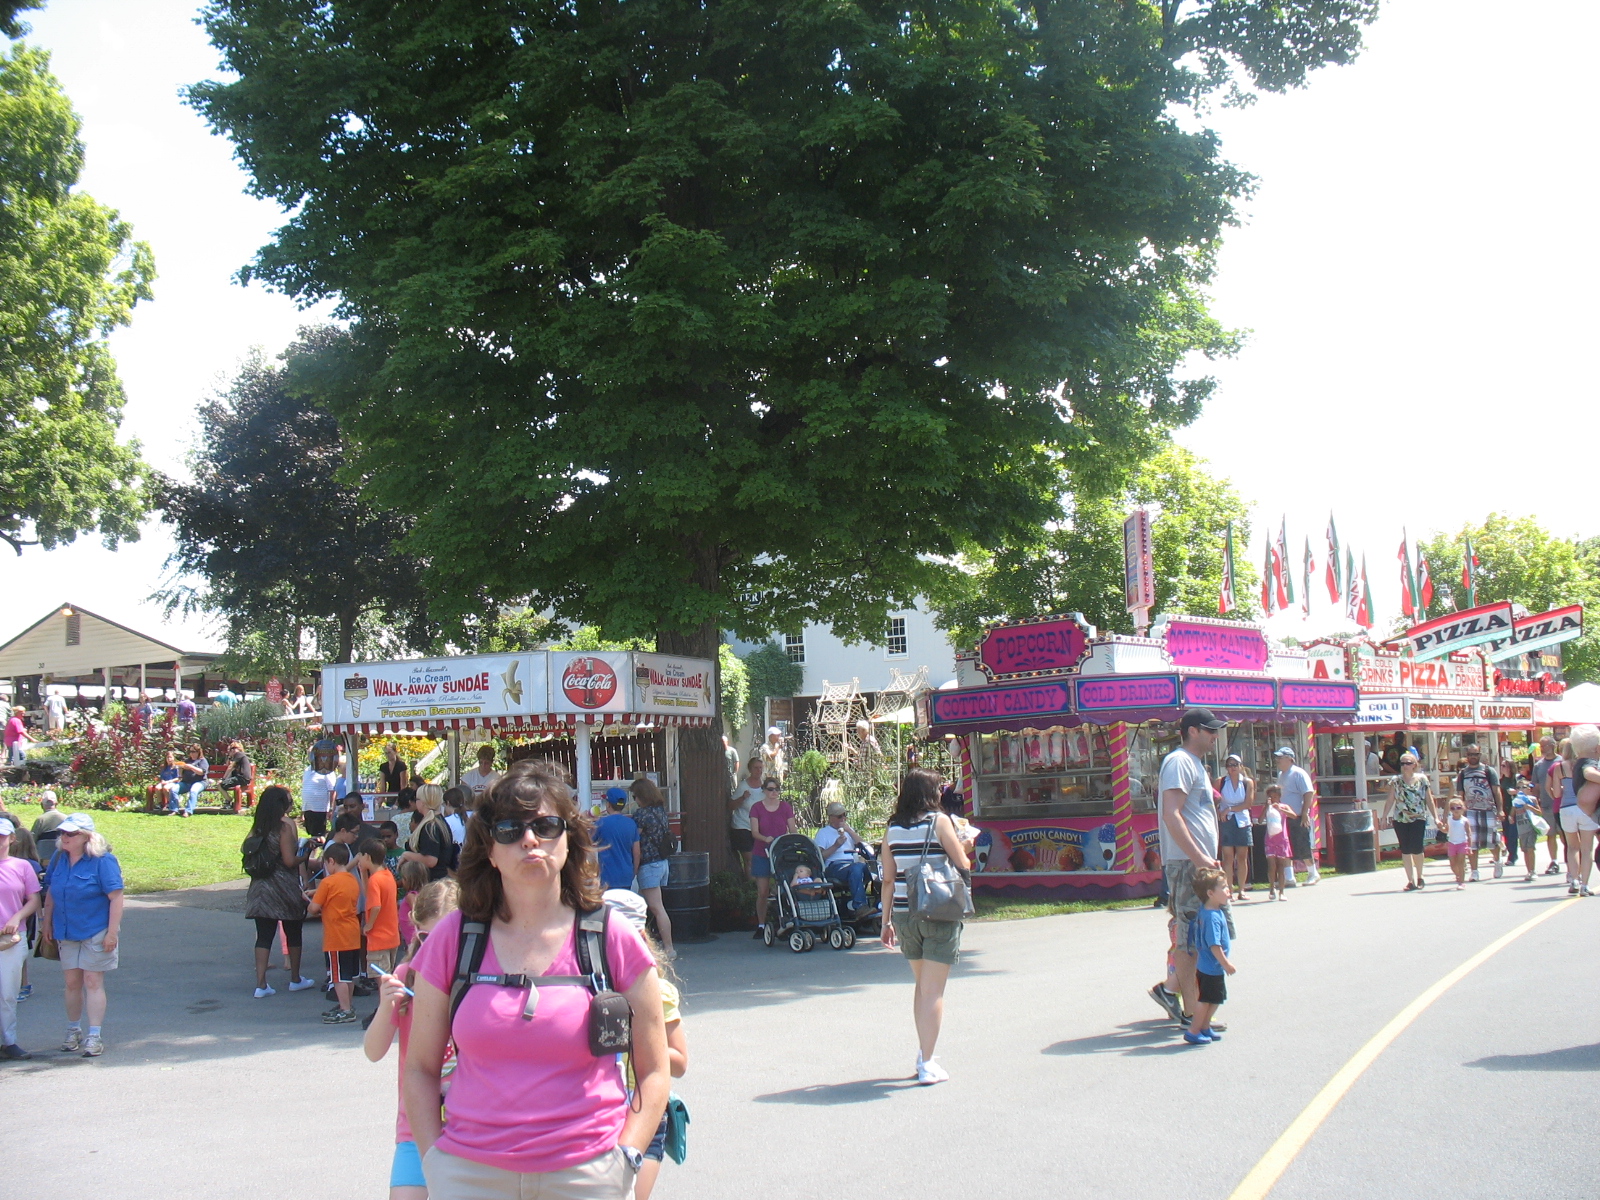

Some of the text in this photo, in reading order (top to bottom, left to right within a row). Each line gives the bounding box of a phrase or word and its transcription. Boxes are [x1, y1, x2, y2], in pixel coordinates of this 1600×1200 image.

[1413, 614, 1509, 652] PIZZA
[996, 630, 1073, 664] POPCORN
[1170, 629, 1261, 664] COTTON CANDY
[408, 674, 452, 684] Ice Cream
[564, 673, 615, 690] Coca-Cola
[649, 668, 702, 689] WALK-AWAY SUNDAE
[1361, 668, 1394, 683] DRINKS
[1400, 661, 1449, 687] PIZZA
[1455, 674, 1482, 688] DRINKS
[373, 672, 489, 697] WALK-AWAY SUNDAE
[1083, 683, 1171, 703] COLD DRINKS
[1194, 683, 1266, 702] COTTON CANDY
[942, 688, 1057, 717] COTTON CANDY
[1292, 687, 1346, 704] POPCORN
[381, 706, 481, 719] Frozen Banana
[1368, 702, 1399, 712] COLD
[1410, 703, 1473, 719] STROMBOLI
[1480, 705, 1531, 720] CALZONES
[1357, 713, 1393, 722] RINKS
[1011, 831, 1082, 844] COTTON CANDY!
[1144, 833, 1160, 844] COTT
